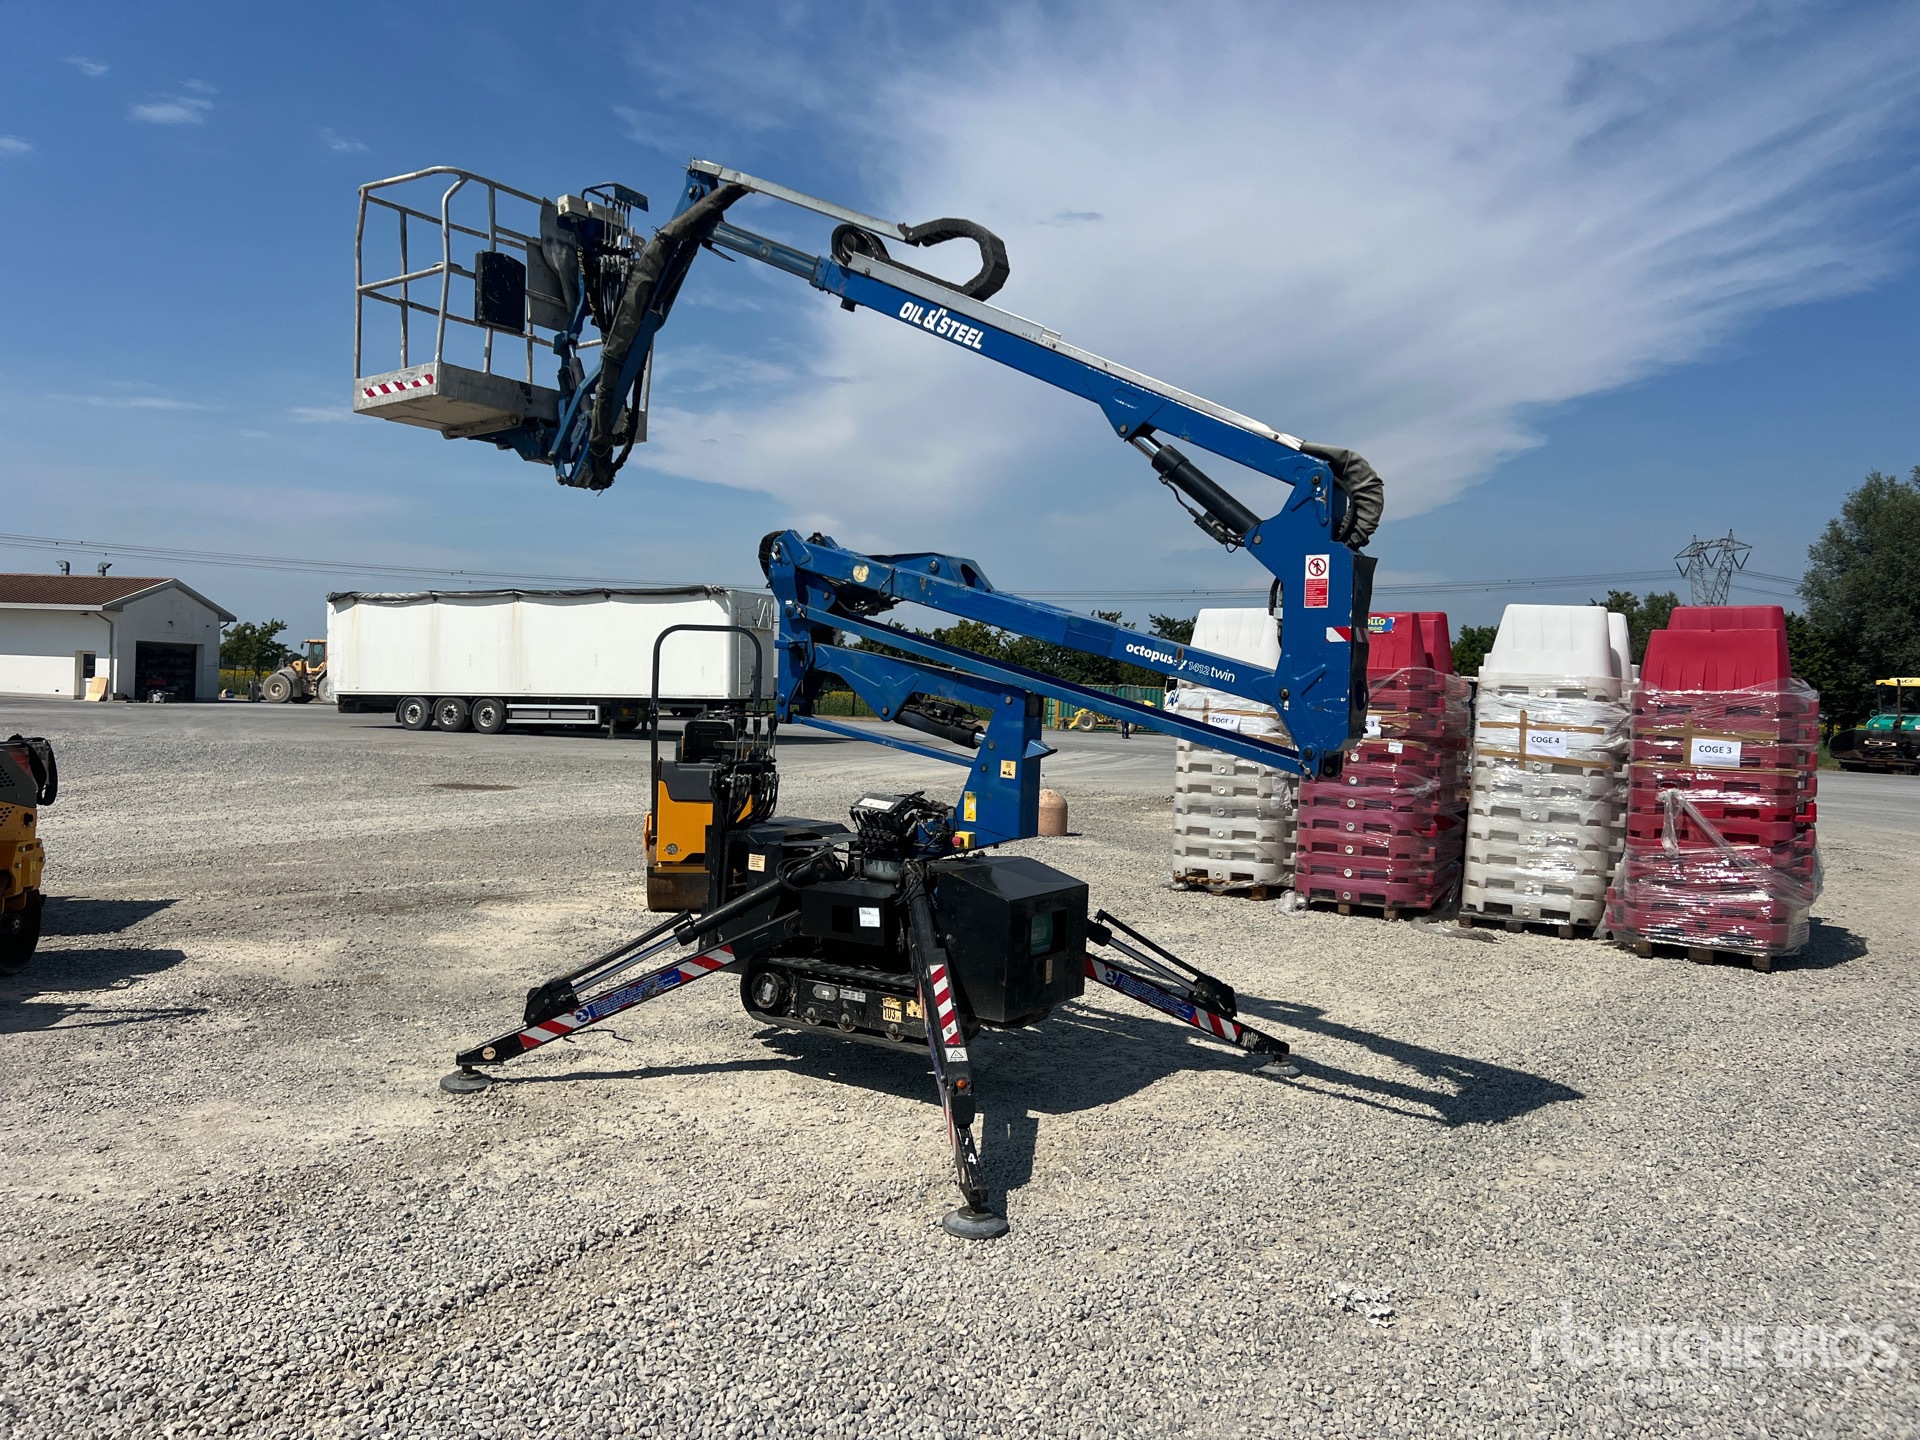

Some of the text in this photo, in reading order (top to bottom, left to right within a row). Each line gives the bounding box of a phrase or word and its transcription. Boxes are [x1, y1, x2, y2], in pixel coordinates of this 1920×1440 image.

[1188, 661, 1210, 676] 1412
[1211, 665, 1236, 683] twin
[1531, 736, 1553, 744] COGE
[1699, 745, 1732, 755] COGE 3
[967, 1152, 977, 1165] 4
